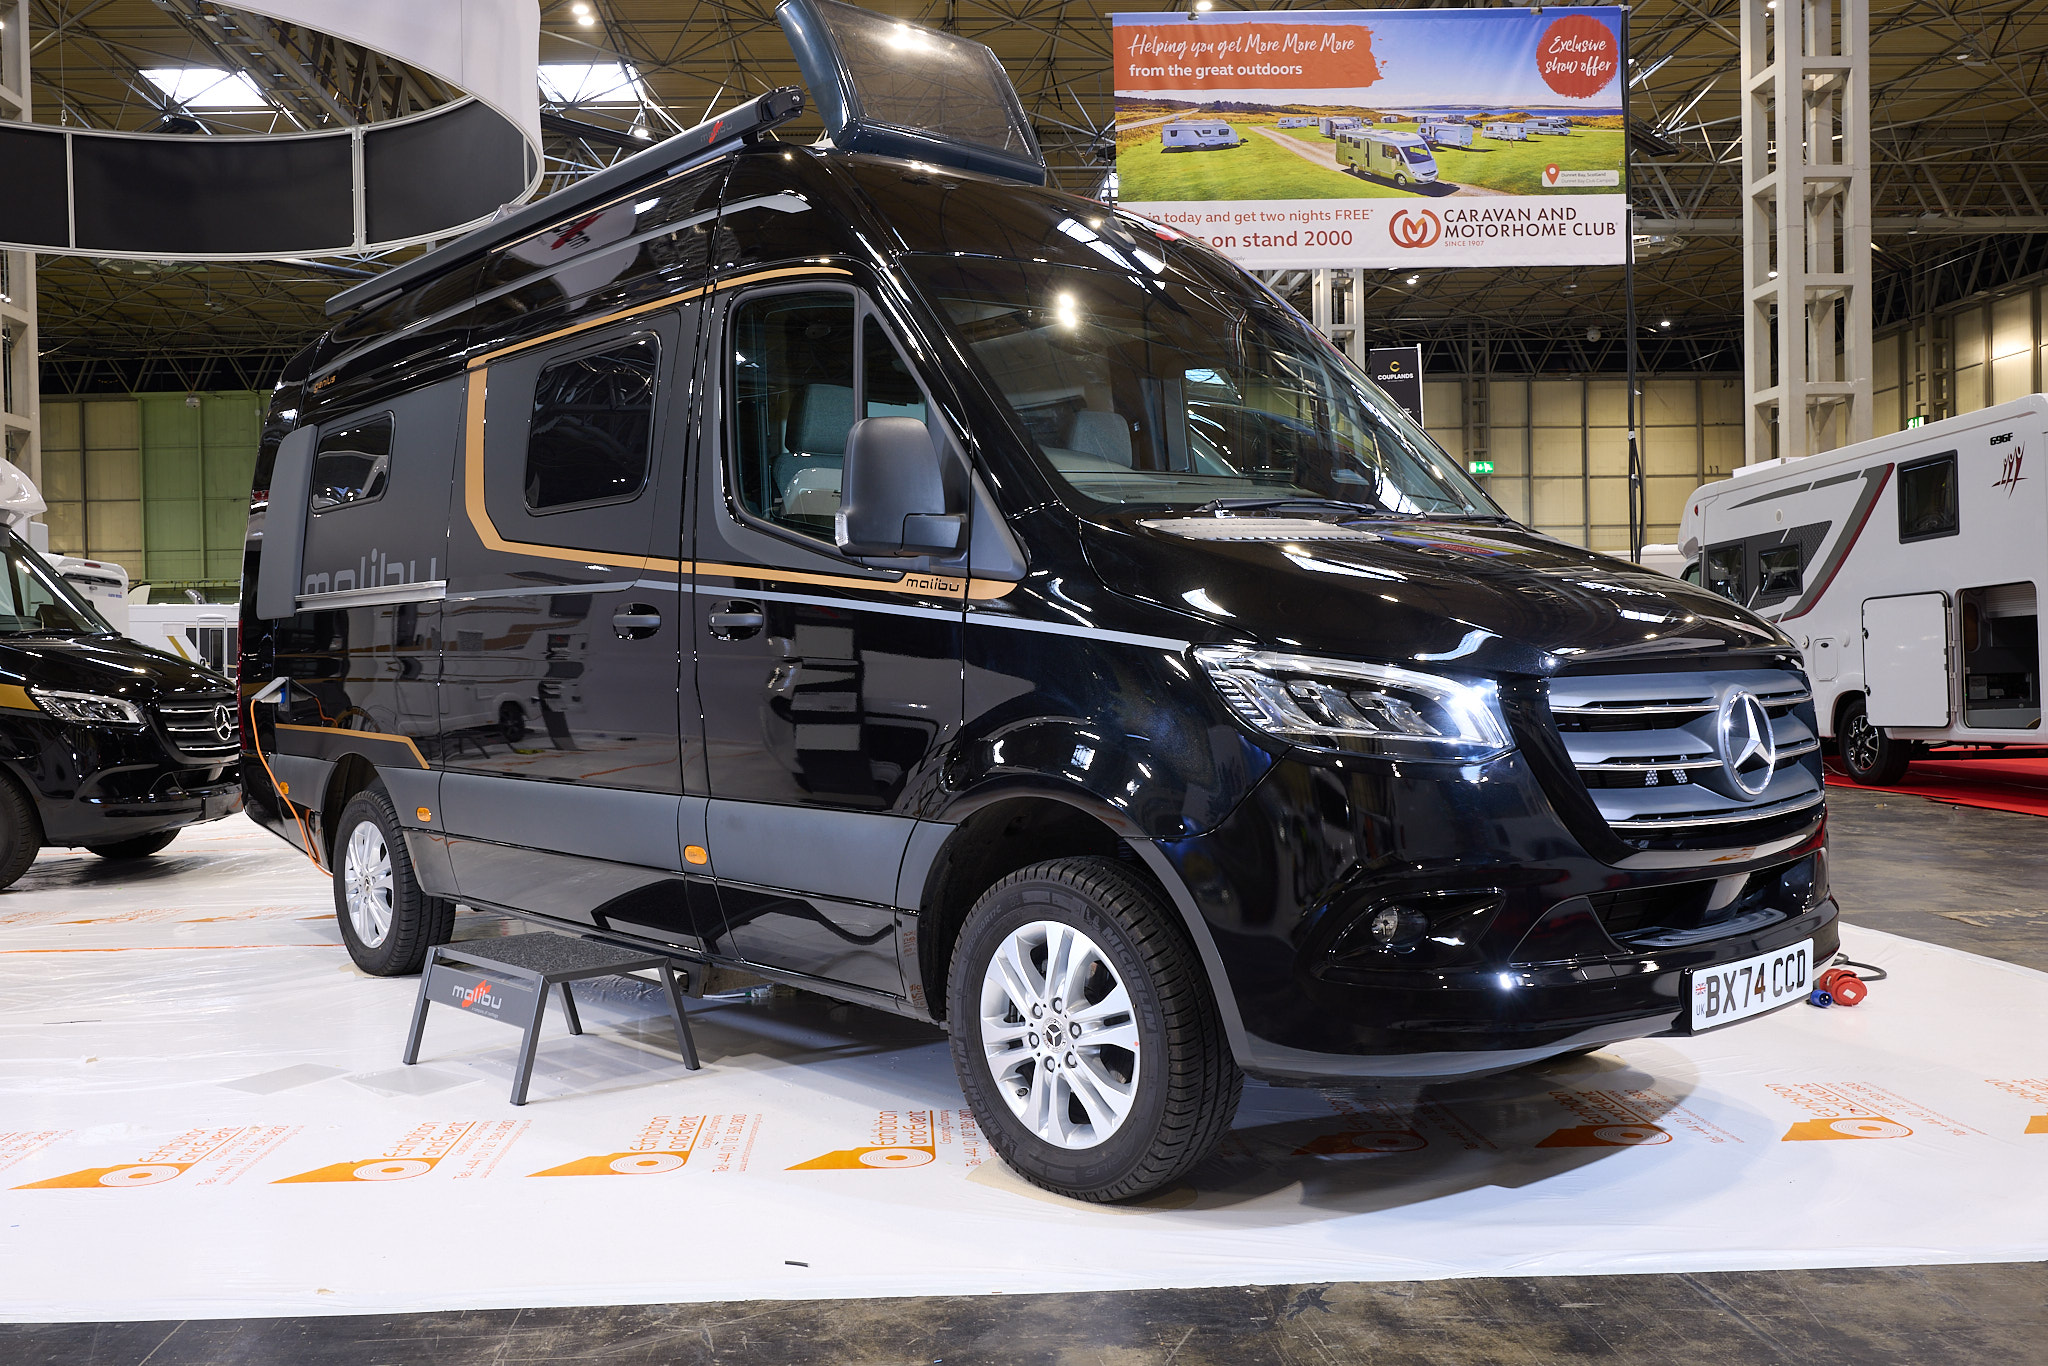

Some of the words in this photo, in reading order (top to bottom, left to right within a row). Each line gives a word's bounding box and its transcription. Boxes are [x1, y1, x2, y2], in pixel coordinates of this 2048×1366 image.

[1128, 33, 1187, 60] Helping
[1191, 41, 1214, 59] you
[1218, 35, 1242, 60] get
[1245, 33, 1280, 54] More
[1282, 33, 1317, 54] More
[1320, 32, 1355, 53] More
[1548, 34, 1607, 54] Exclusive
[1129, 63, 1165, 77] from
[1168, 63, 1193, 77] the
[1195, 64, 1234, 79] great
[1237, 62, 1303, 76] outdoors
[1545, 57, 1578, 74] show
[1581, 55, 1612, 77] offer
[1164, 211, 1202, 226] today
[1206, 211, 1230, 223] and
[1234, 212, 1257, 226] get
[1260, 212, 1285, 222] two
[1289, 209, 1331, 225] nights
[1444, 208, 1531, 223] CARAVAN
[1537, 207, 1577, 221] AND
[1211, 235, 1237, 248] on
[1242, 231, 1298, 248] stand
[1304, 230, 1353, 247] 2000
[1444, 223, 1566, 238] MOTORHOME
[1377, 373, 1414, 381] COUPLANDS
[1990, 432, 2013, 446] 696F
[906, 577, 959, 592] malibu
[1102, 926, 1158, 1034] MICHELIN
[1706, 962, 1766, 1018] BX74
[1773, 949, 1805, 998] CCD
[452, 985, 502, 1010] malibu
[1696, 1003, 1705, 1016] UK
